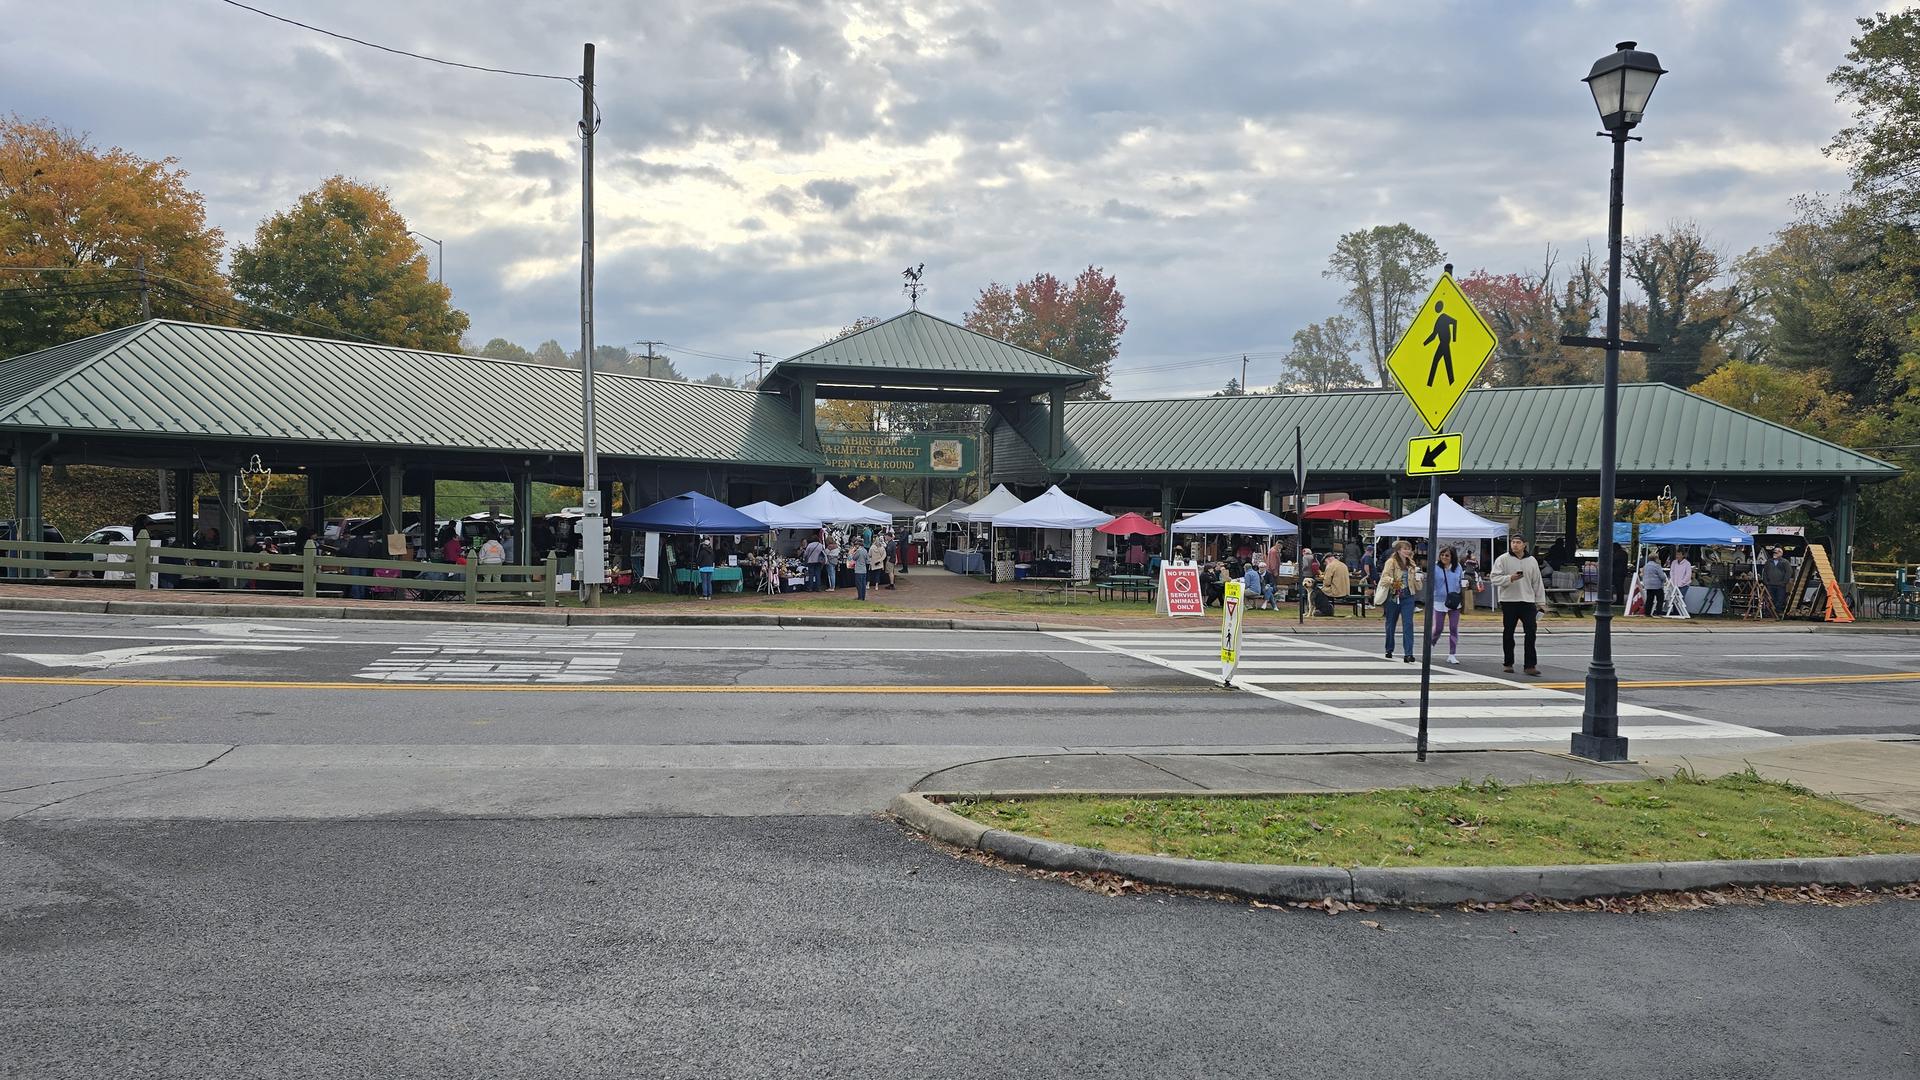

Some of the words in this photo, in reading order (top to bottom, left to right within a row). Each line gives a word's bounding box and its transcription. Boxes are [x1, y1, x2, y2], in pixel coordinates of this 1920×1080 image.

[842, 436, 898, 446] ABINGDON
[875, 446, 922, 457] MARKET
[853, 459, 881, 469] YEAR
[883, 460, 914, 469] ROUND
